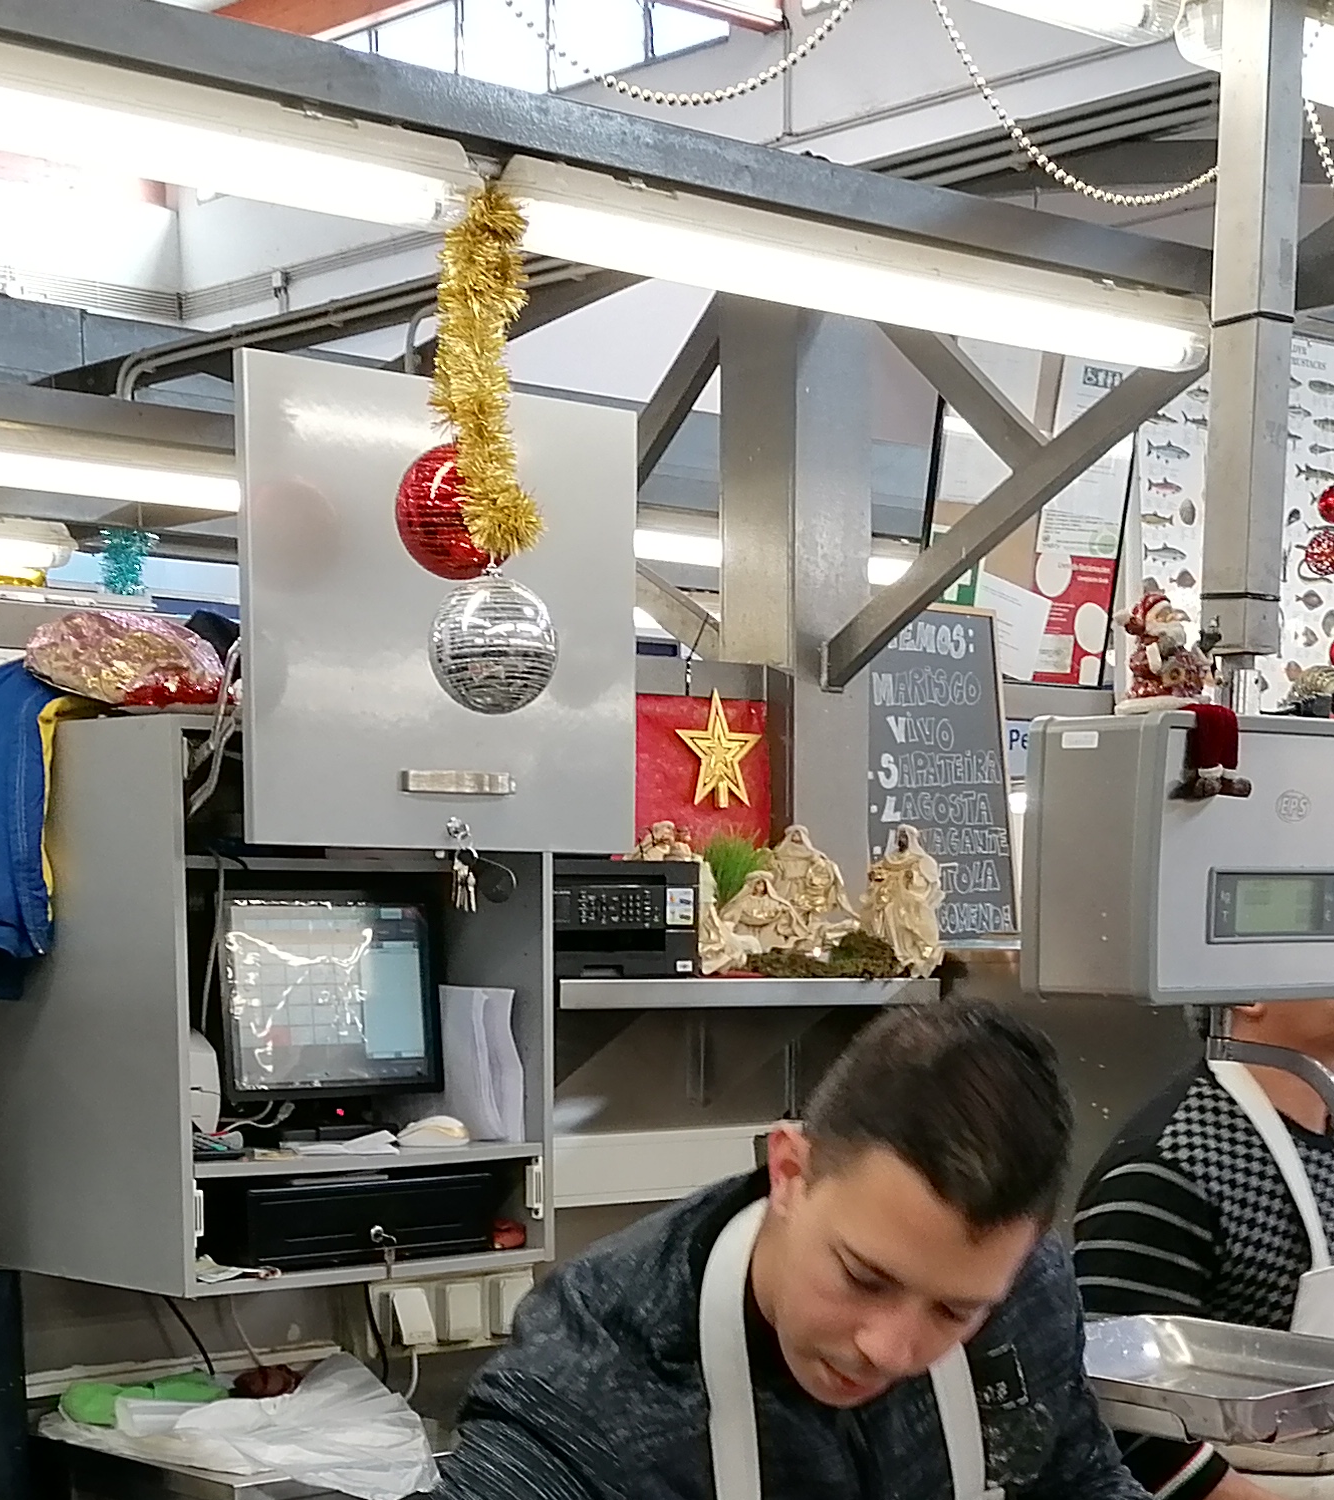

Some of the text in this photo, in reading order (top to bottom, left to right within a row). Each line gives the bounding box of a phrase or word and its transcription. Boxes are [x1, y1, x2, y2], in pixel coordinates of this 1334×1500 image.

[888, 622, 974, 659] EMOS:
[881, 791, 993, 825] LAGOSTA
[1280, 798, 1308, 817] EPS
